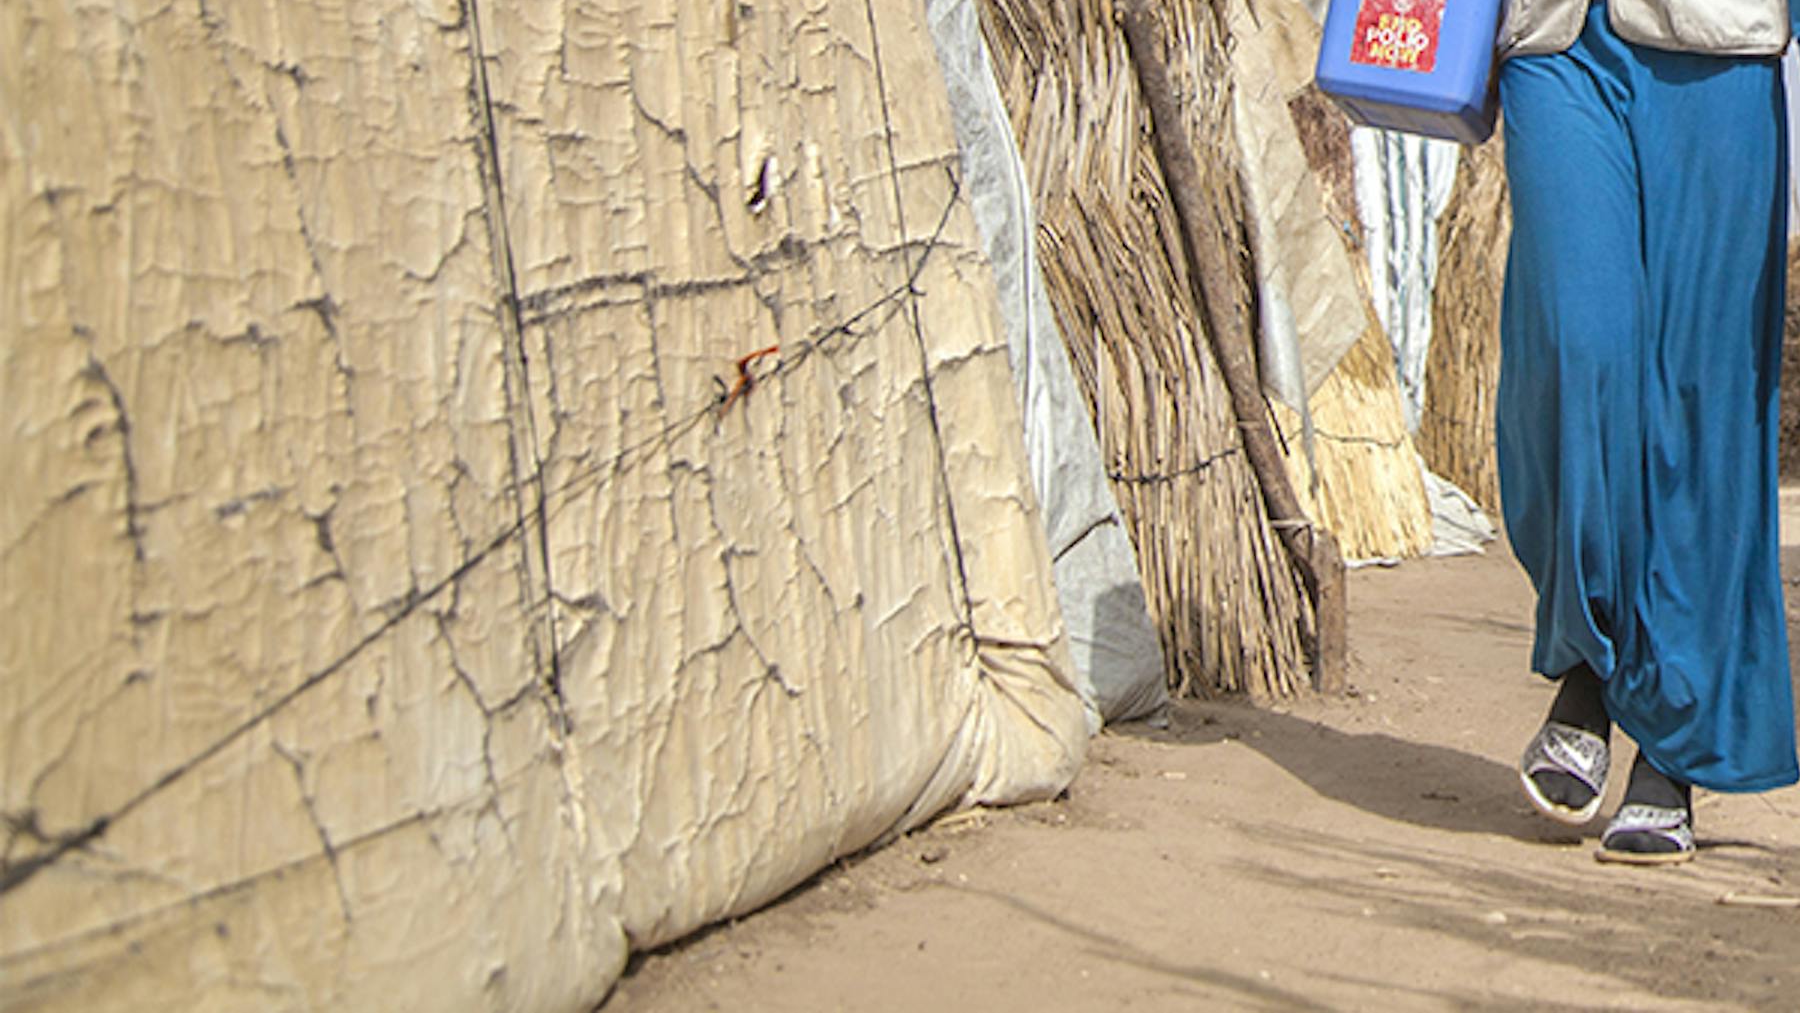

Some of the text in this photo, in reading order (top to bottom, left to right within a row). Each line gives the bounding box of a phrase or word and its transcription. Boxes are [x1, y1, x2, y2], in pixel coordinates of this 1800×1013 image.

[1378, 13, 1423, 33] END
[1367, 26, 1429, 51] POLIO
[1369, 42, 1421, 63] NOW
